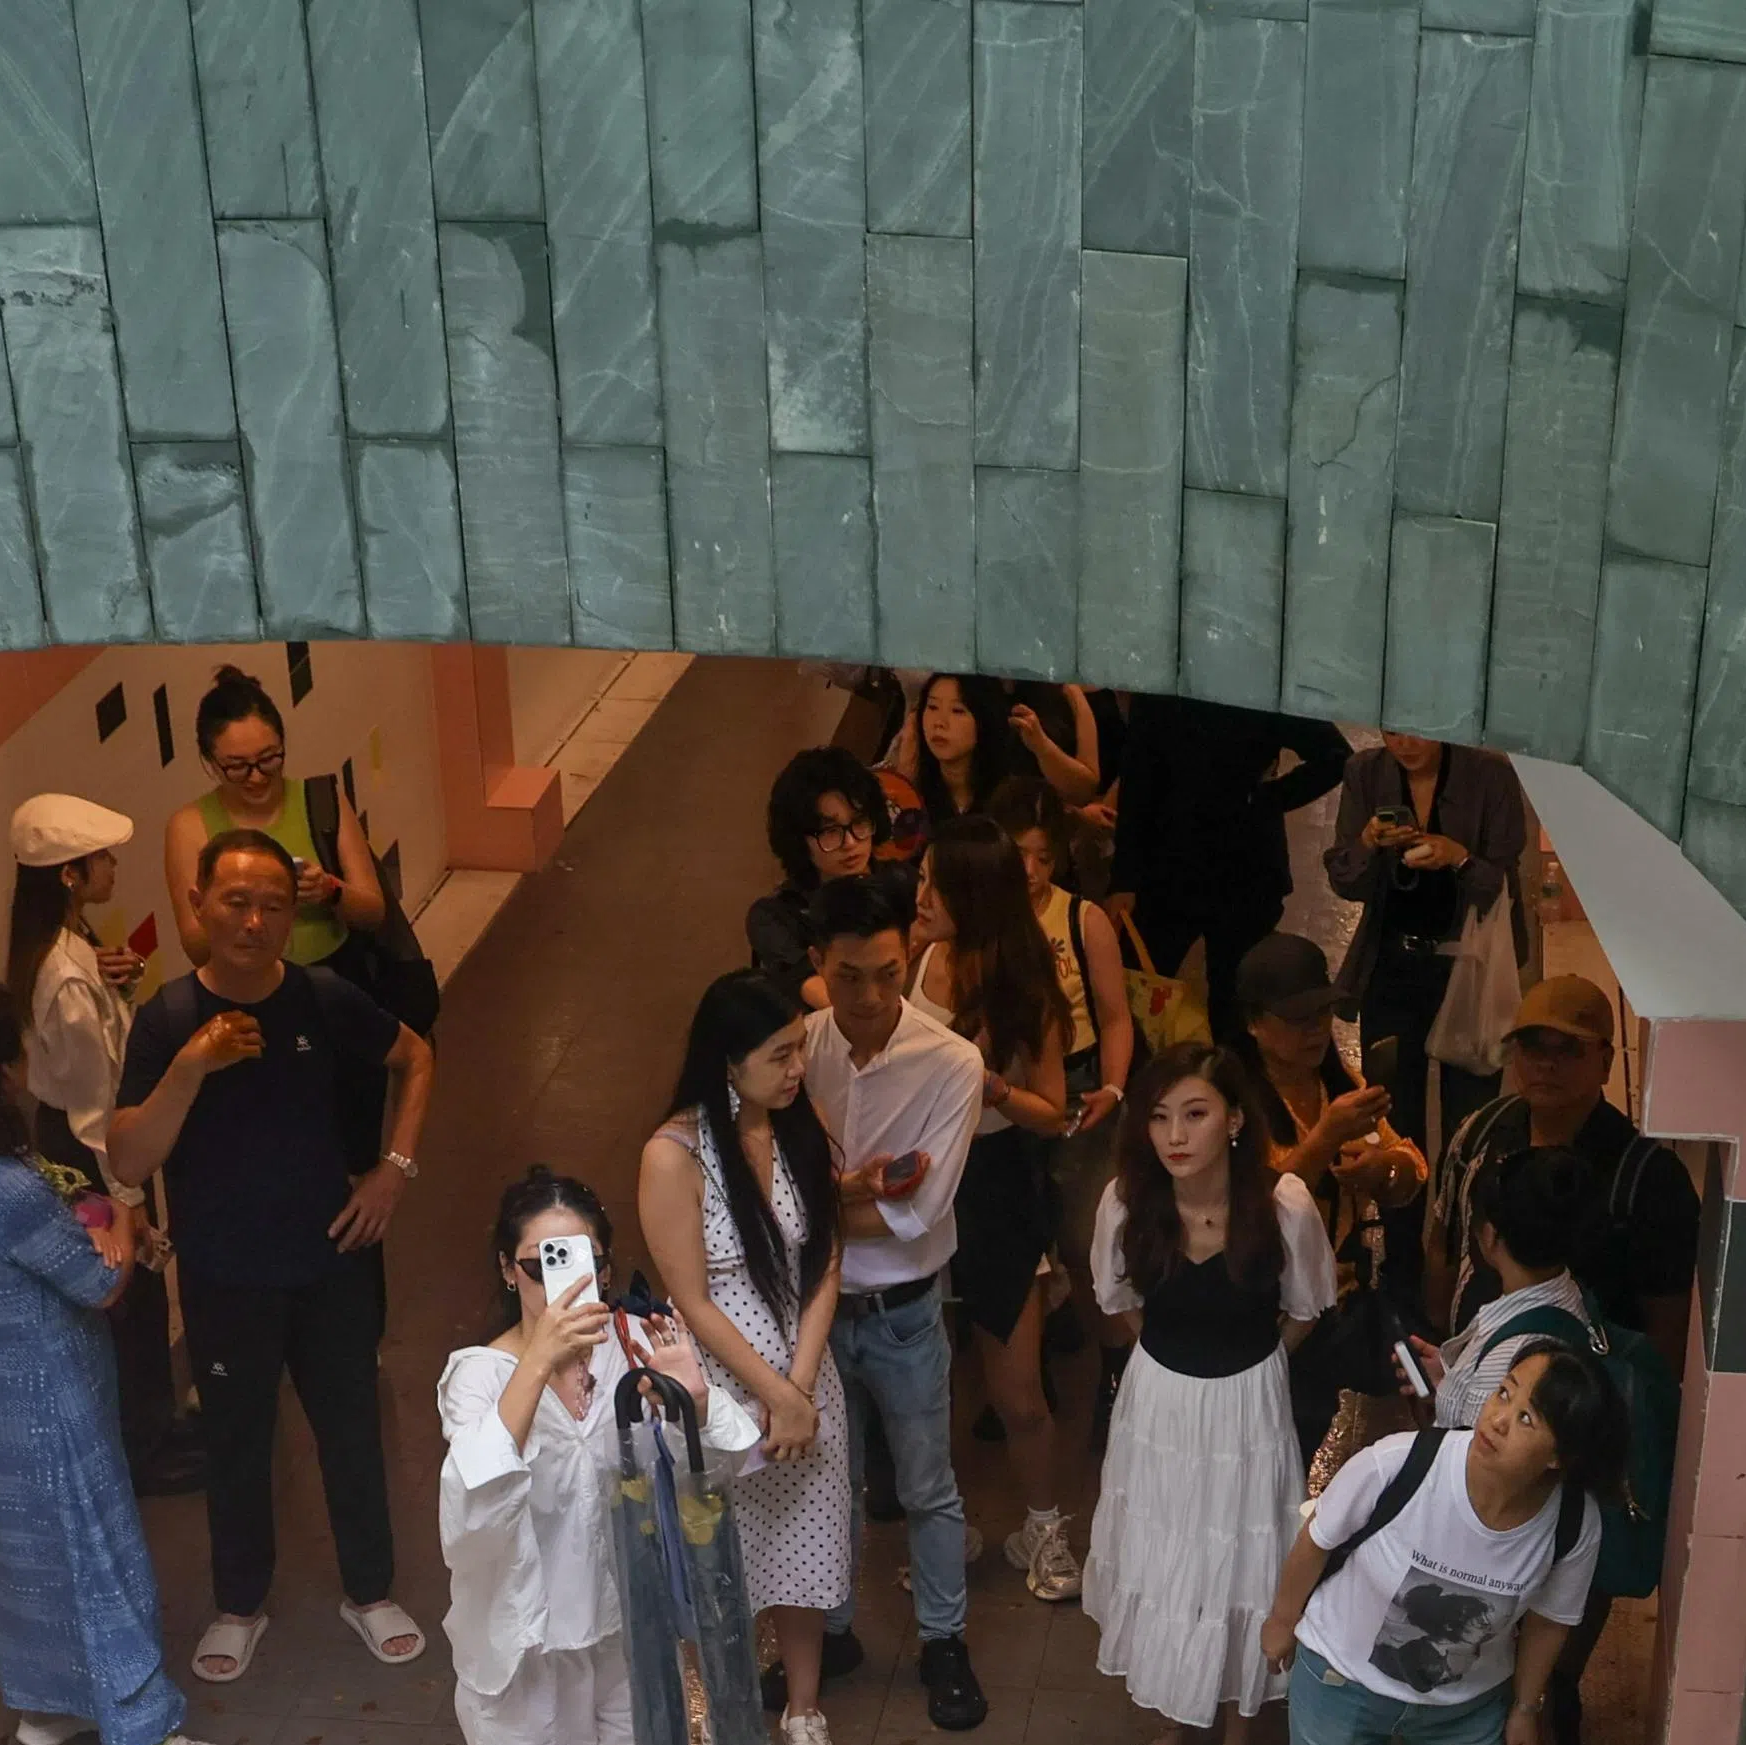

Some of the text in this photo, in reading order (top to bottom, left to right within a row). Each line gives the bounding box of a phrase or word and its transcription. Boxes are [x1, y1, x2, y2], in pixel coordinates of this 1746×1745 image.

[1411, 1549, 1437, 1570] What
[1438, 1561, 1448, 1574] is
[1449, 1567, 1487, 1587] normal
